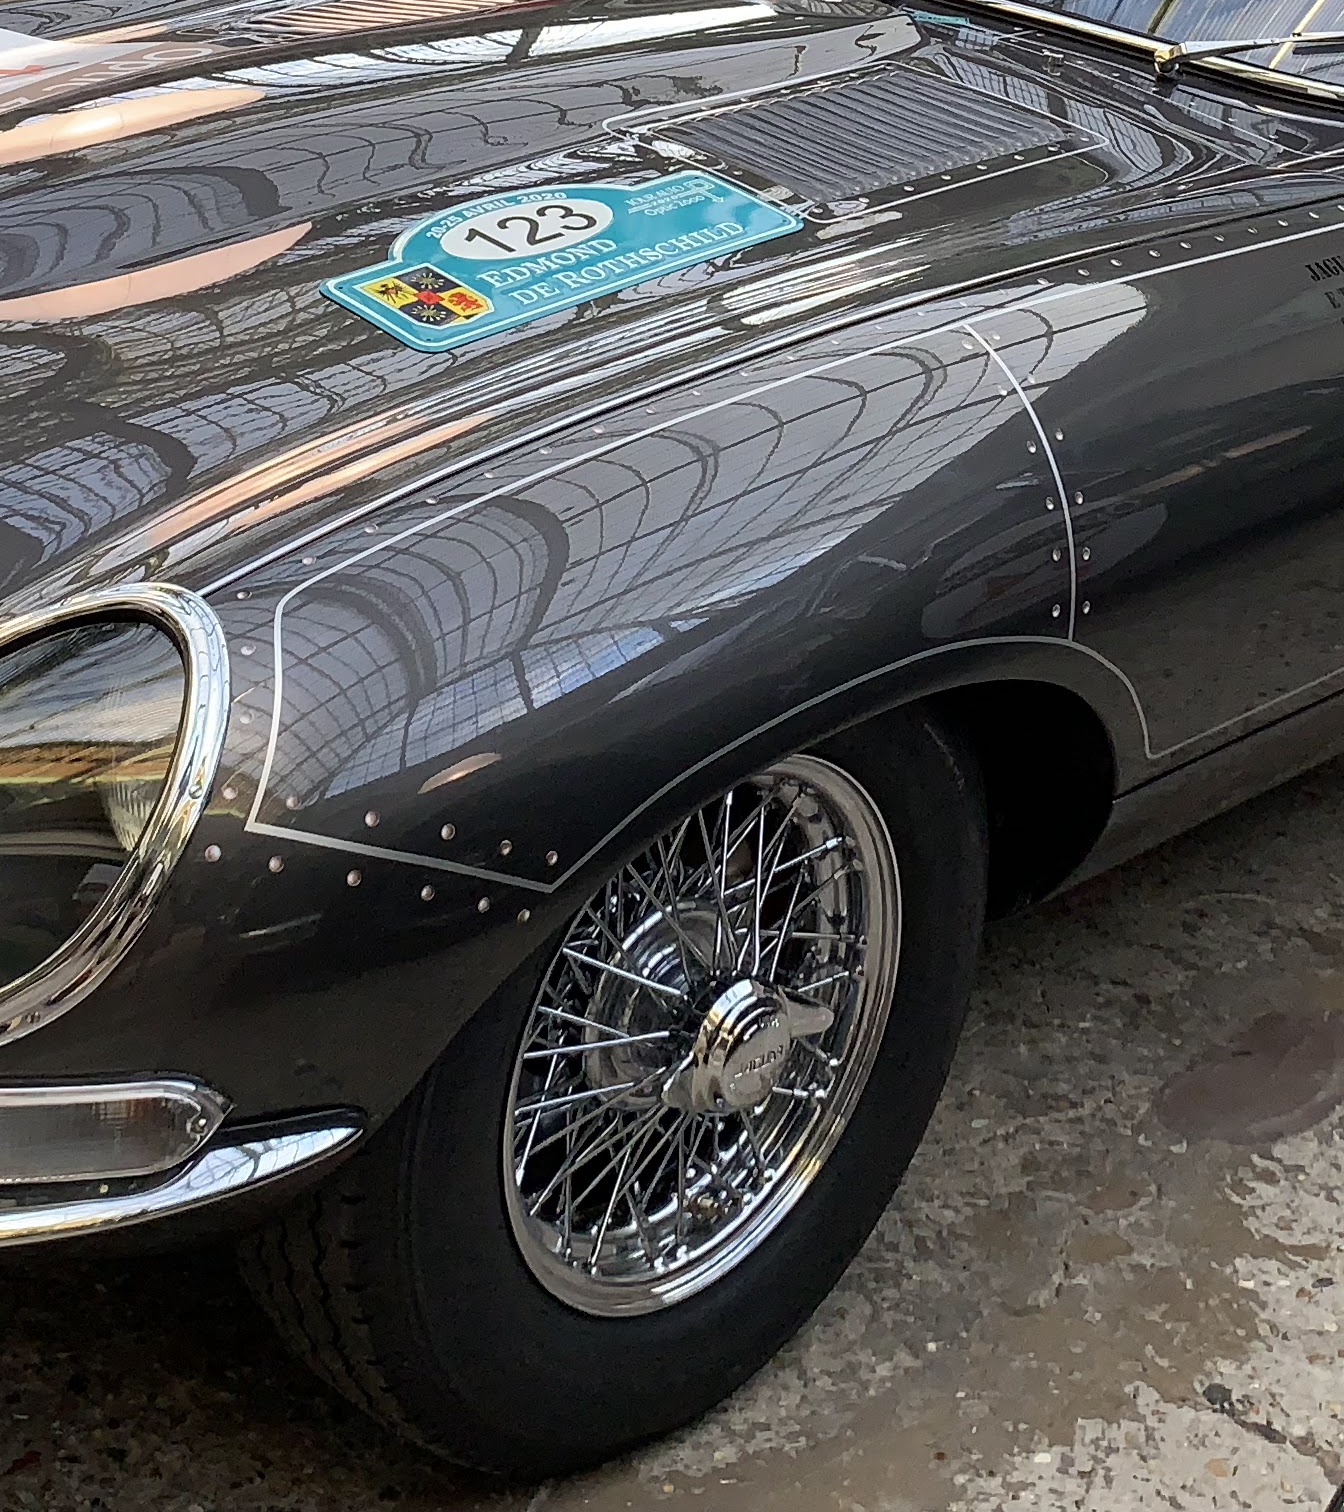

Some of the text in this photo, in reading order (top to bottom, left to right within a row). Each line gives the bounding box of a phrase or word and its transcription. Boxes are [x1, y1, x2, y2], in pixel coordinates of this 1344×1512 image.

[425, 190, 568, 240] 20-25 AVRIL 2020
[642, 194, 707, 217] Optic 2000
[656, 184, 685, 203] AUTO
[464, 204, 598, 255] 123
[476, 237, 619, 290] EDMOND
[508, 220, 748, 307] DE ROTHSCHILD
[1324, 290, 1341, 309] E
